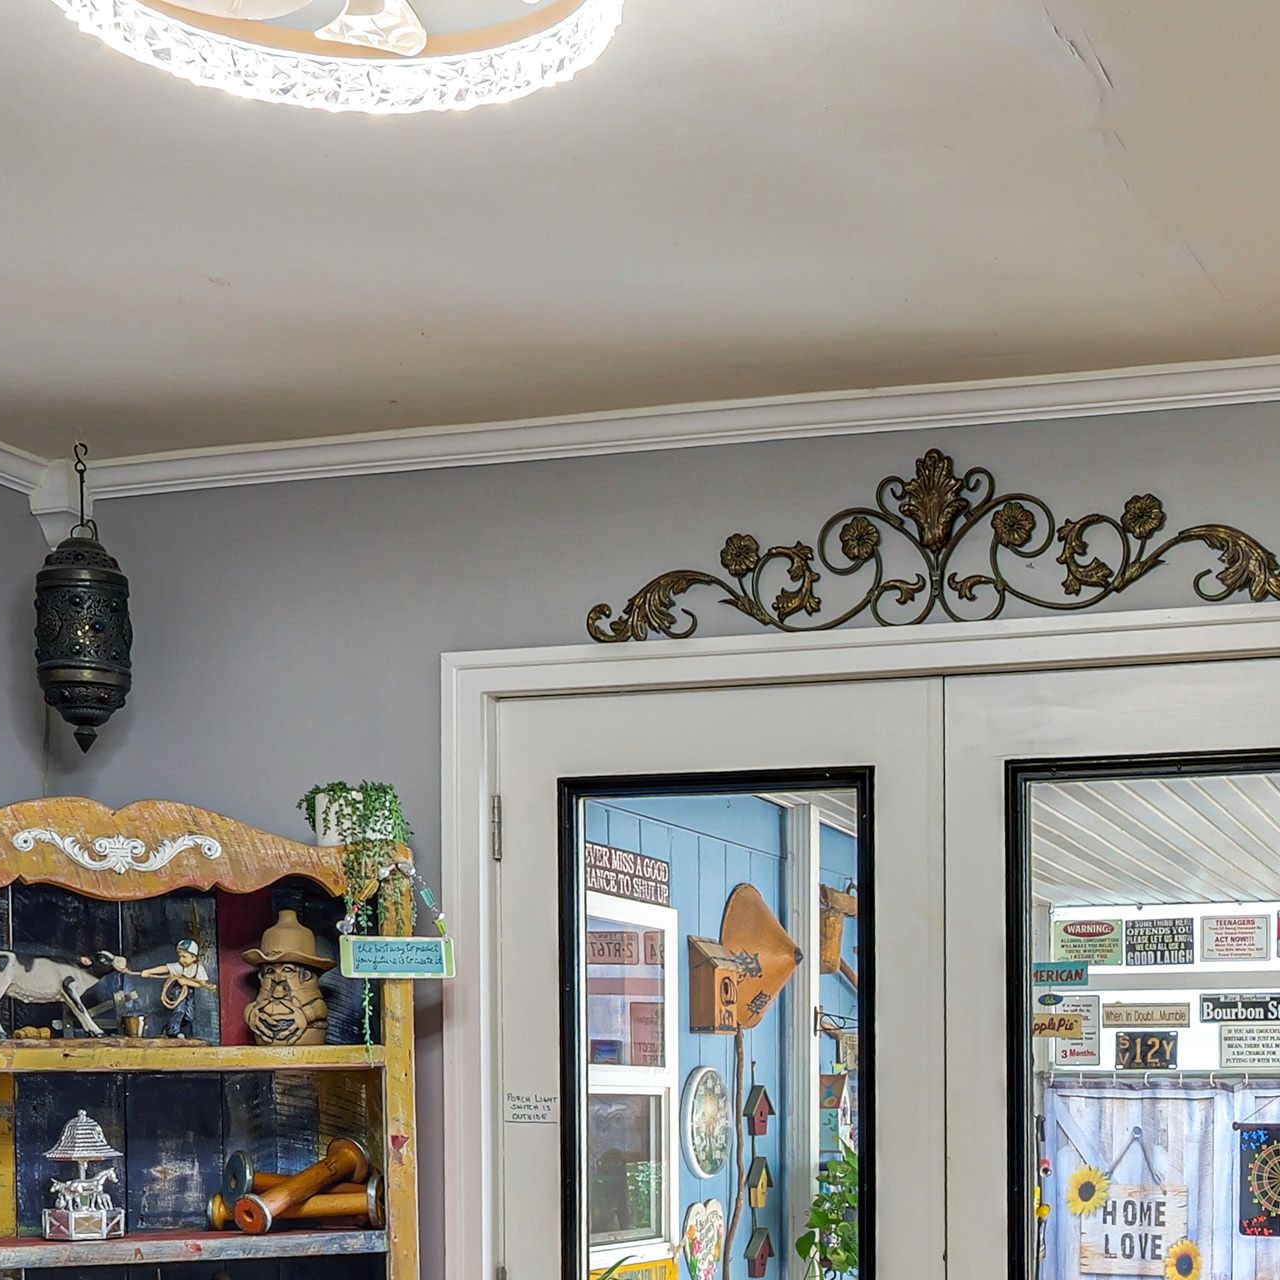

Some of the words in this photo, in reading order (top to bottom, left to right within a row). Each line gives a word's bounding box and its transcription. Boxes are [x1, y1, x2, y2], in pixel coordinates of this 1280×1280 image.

[611, 849, 634, 874] MISS
[636, 856, 643, 876] A
[643, 858, 668, 882] GOOD
[618, 873, 632, 896] TO
[633, 877, 656, 901] SHUT
[1127, 927, 1170, 936] OFFENDS
[1172, 926, 1193, 934] YOU
[1127, 936, 1149, 944] PLEASE
[1150, 935, 1163, 943] LET
[358, 943, 373, 953] the
[1127, 951, 1154, 965] GOOD
[1155, 950, 1193, 964] LAUGH
[1105, 1009, 1122, 1021] When
[1125, 1009, 1132, 1020] In
[1202, 1001, 1264, 1020] Bourbon
[1033, 1017, 1056, 1034] pple
[1119, 1035, 1130, 1049] S
[1061, 1049, 1068, 1059] 3
[1118, 1052, 1130, 1066] V
[1102, 1200, 1166, 1228] HOME
[1104, 1233, 1163, 1260] LOVE
